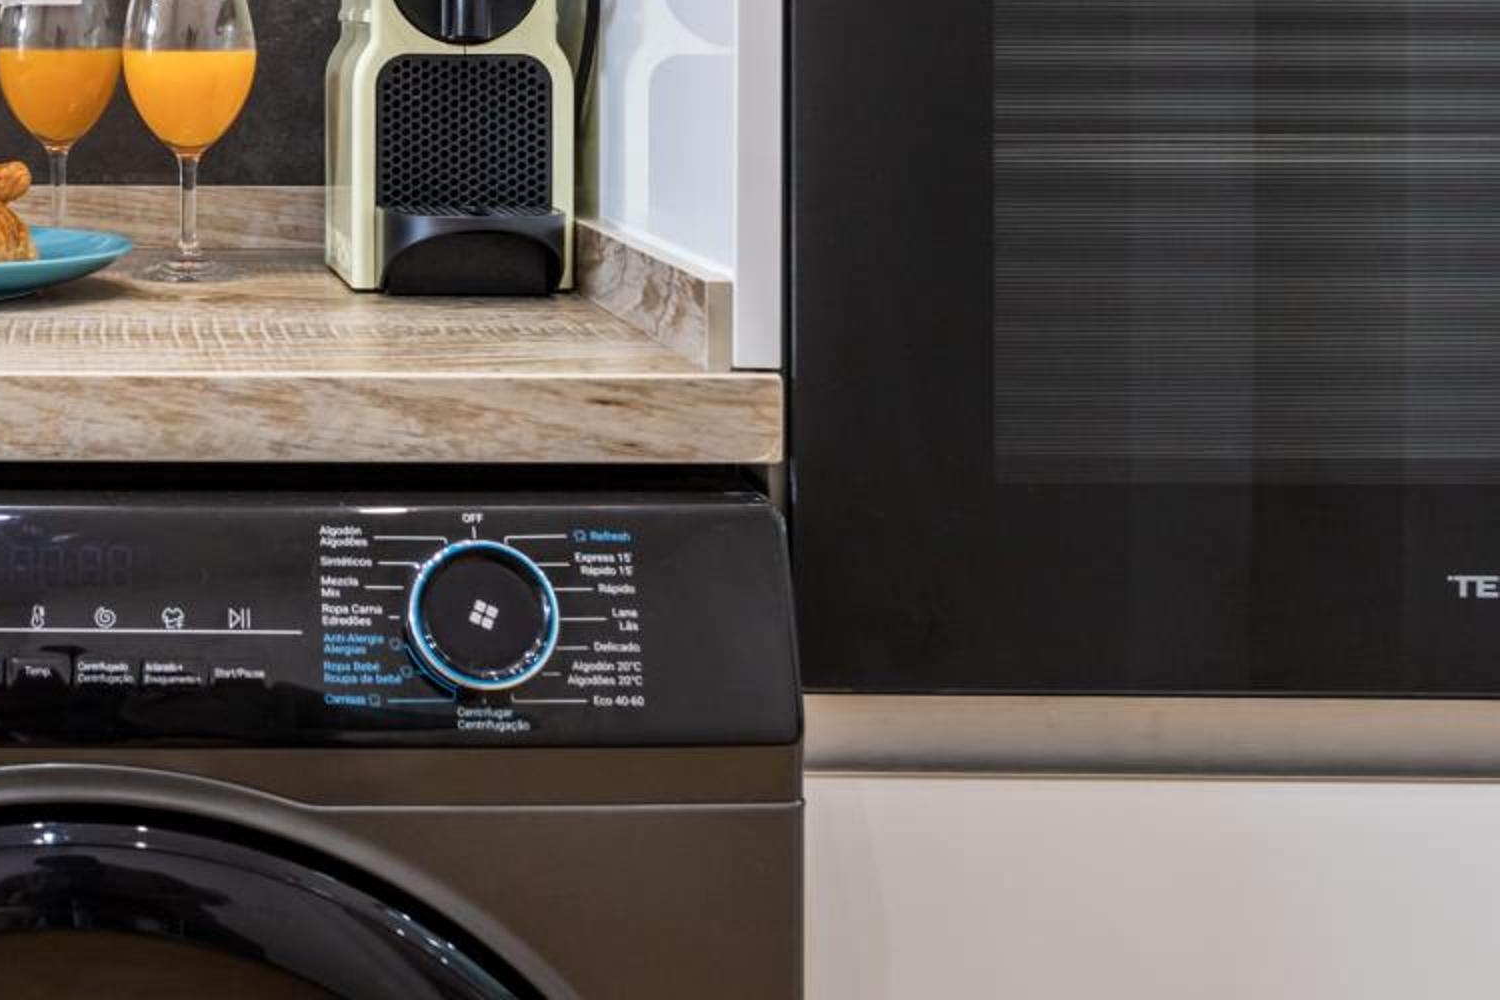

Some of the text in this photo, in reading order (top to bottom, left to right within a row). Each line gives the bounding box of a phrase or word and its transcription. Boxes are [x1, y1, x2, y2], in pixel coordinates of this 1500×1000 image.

[461, 512, 484, 524] OFF
[320, 525, 362, 537] Algodón
[320, 537, 369, 549] Algodões
[320, 556, 372, 567] Sintéticos
[574, 552, 615, 564] Express
[580, 565, 617, 577] Rápido
[321, 576, 359, 587] Mezcla
[321, 588, 340, 598] Mix
[597, 583, 636, 596] Rápido
[322, 604, 383, 616] Ropa Cama
[611, 607, 639, 618] Lana
[322, 615, 372, 626] Edredões
[593, 641, 641, 652] Delicado
[572, 660, 615, 673] Algodón
[360, 674, 373, 685] de
[567, 674, 616, 687] Algodões
[593, 695, 613, 706] Eco
[457, 706, 514, 720] Centrifugar
